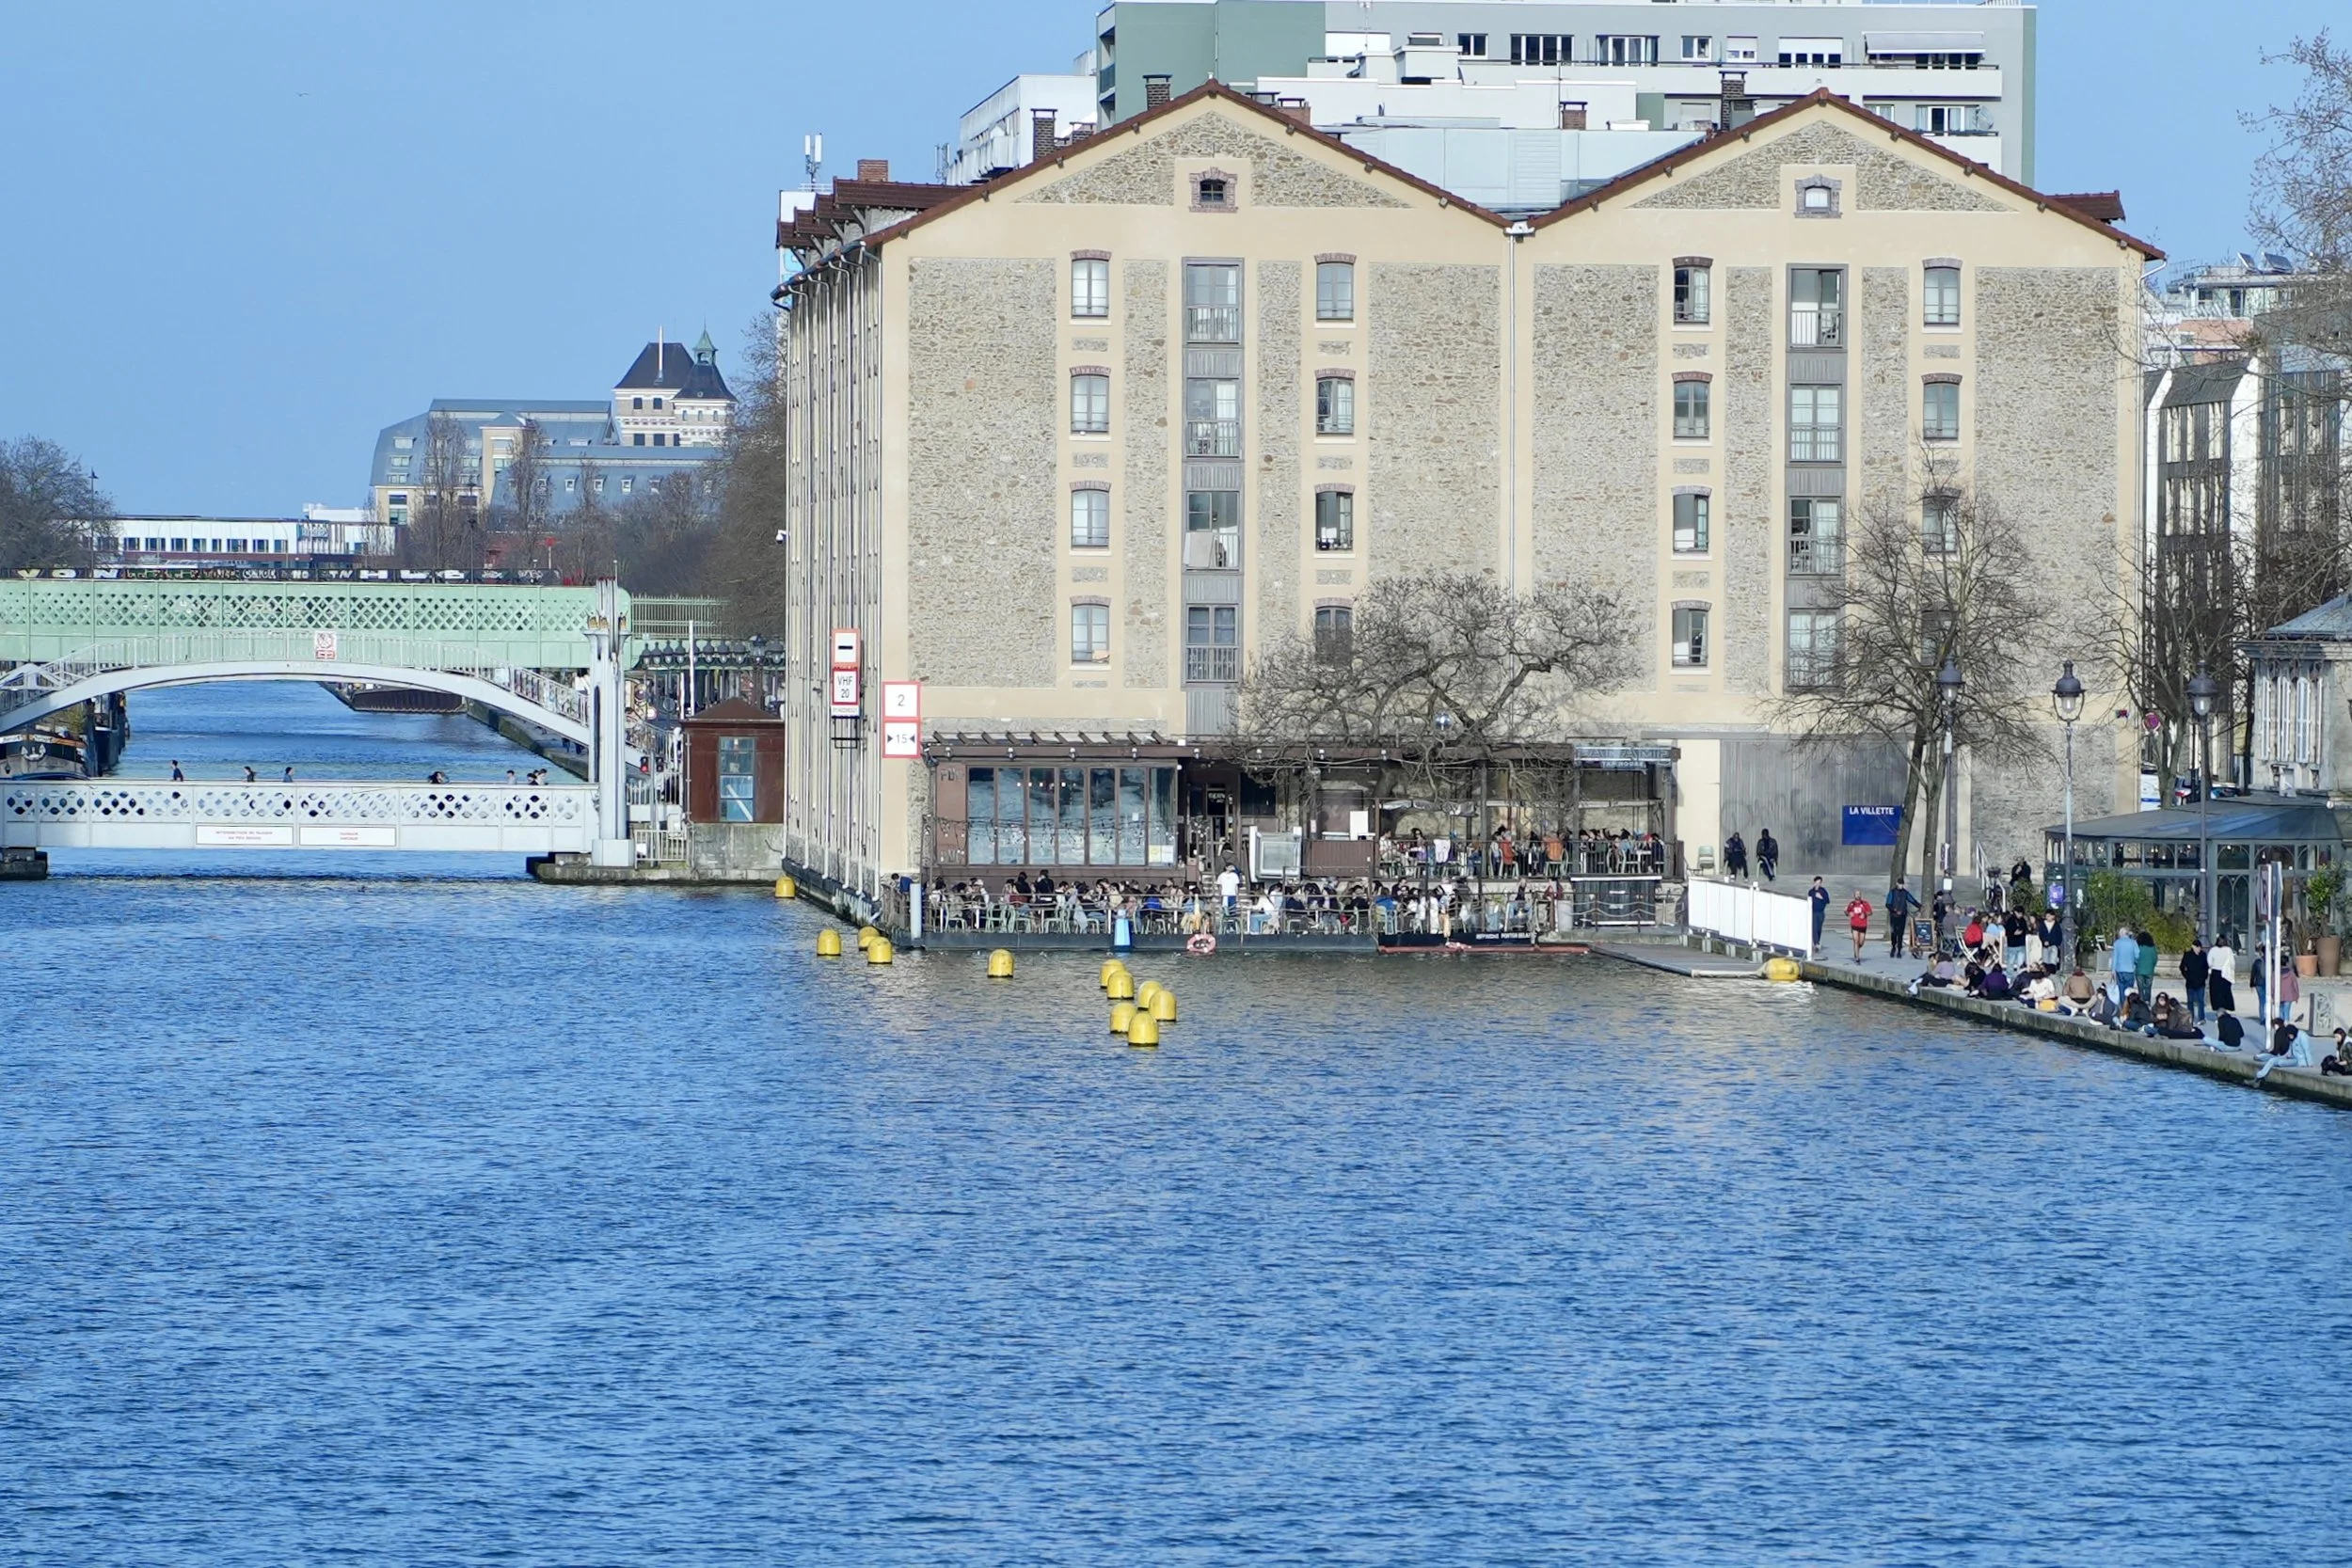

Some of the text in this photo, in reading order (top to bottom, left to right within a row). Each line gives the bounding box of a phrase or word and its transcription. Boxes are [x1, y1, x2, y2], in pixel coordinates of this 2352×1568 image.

[837, 674, 853, 686] VHF
[841, 689, 850, 699] 20
[897, 693, 905, 706] 2
[896, 734, 908, 744] 15
[1850, 806, 1895, 816] LA VILLETTE
